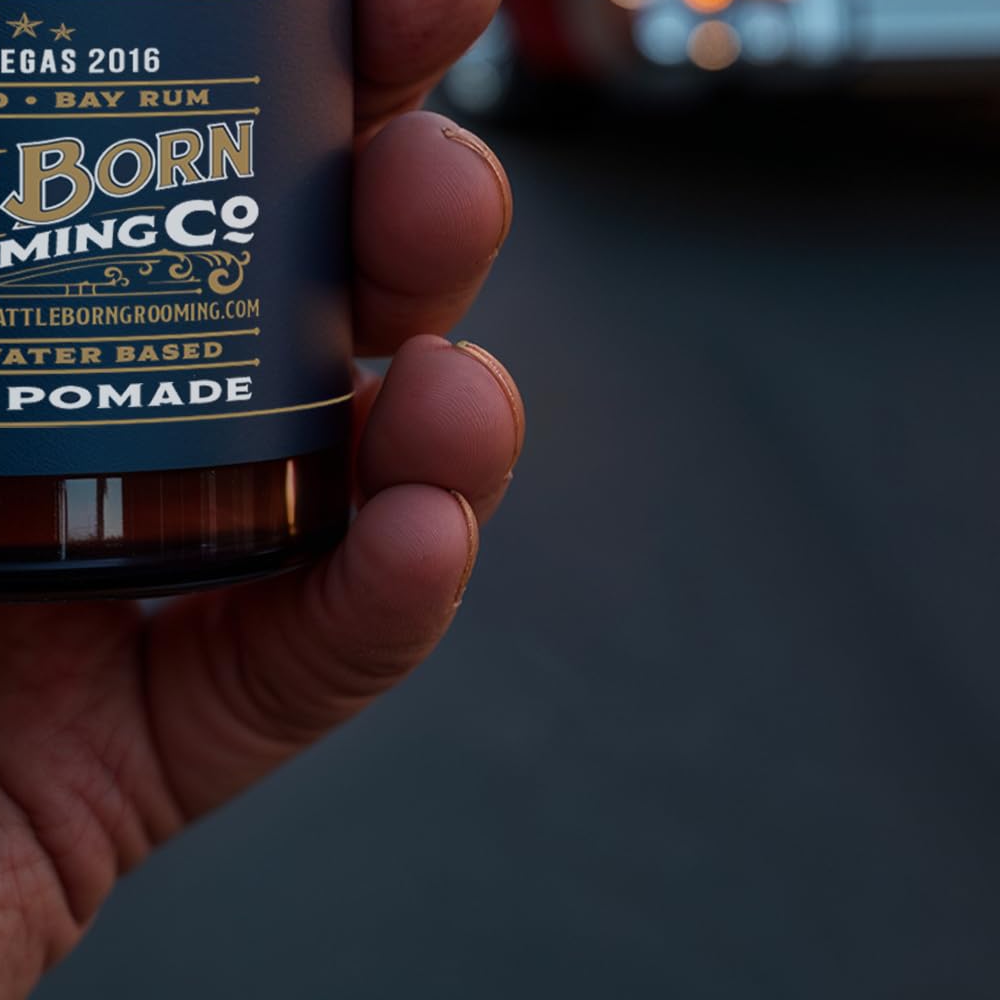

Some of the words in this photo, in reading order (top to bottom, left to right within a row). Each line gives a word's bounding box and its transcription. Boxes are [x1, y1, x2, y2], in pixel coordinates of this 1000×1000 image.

[88, 47, 161, 74] 2016
[55, 90, 125, 109] BAY
[139, 88, 210, 107] RUM
[115, 341, 224, 362] BASED
[6, 377, 253, 411] POMADE
